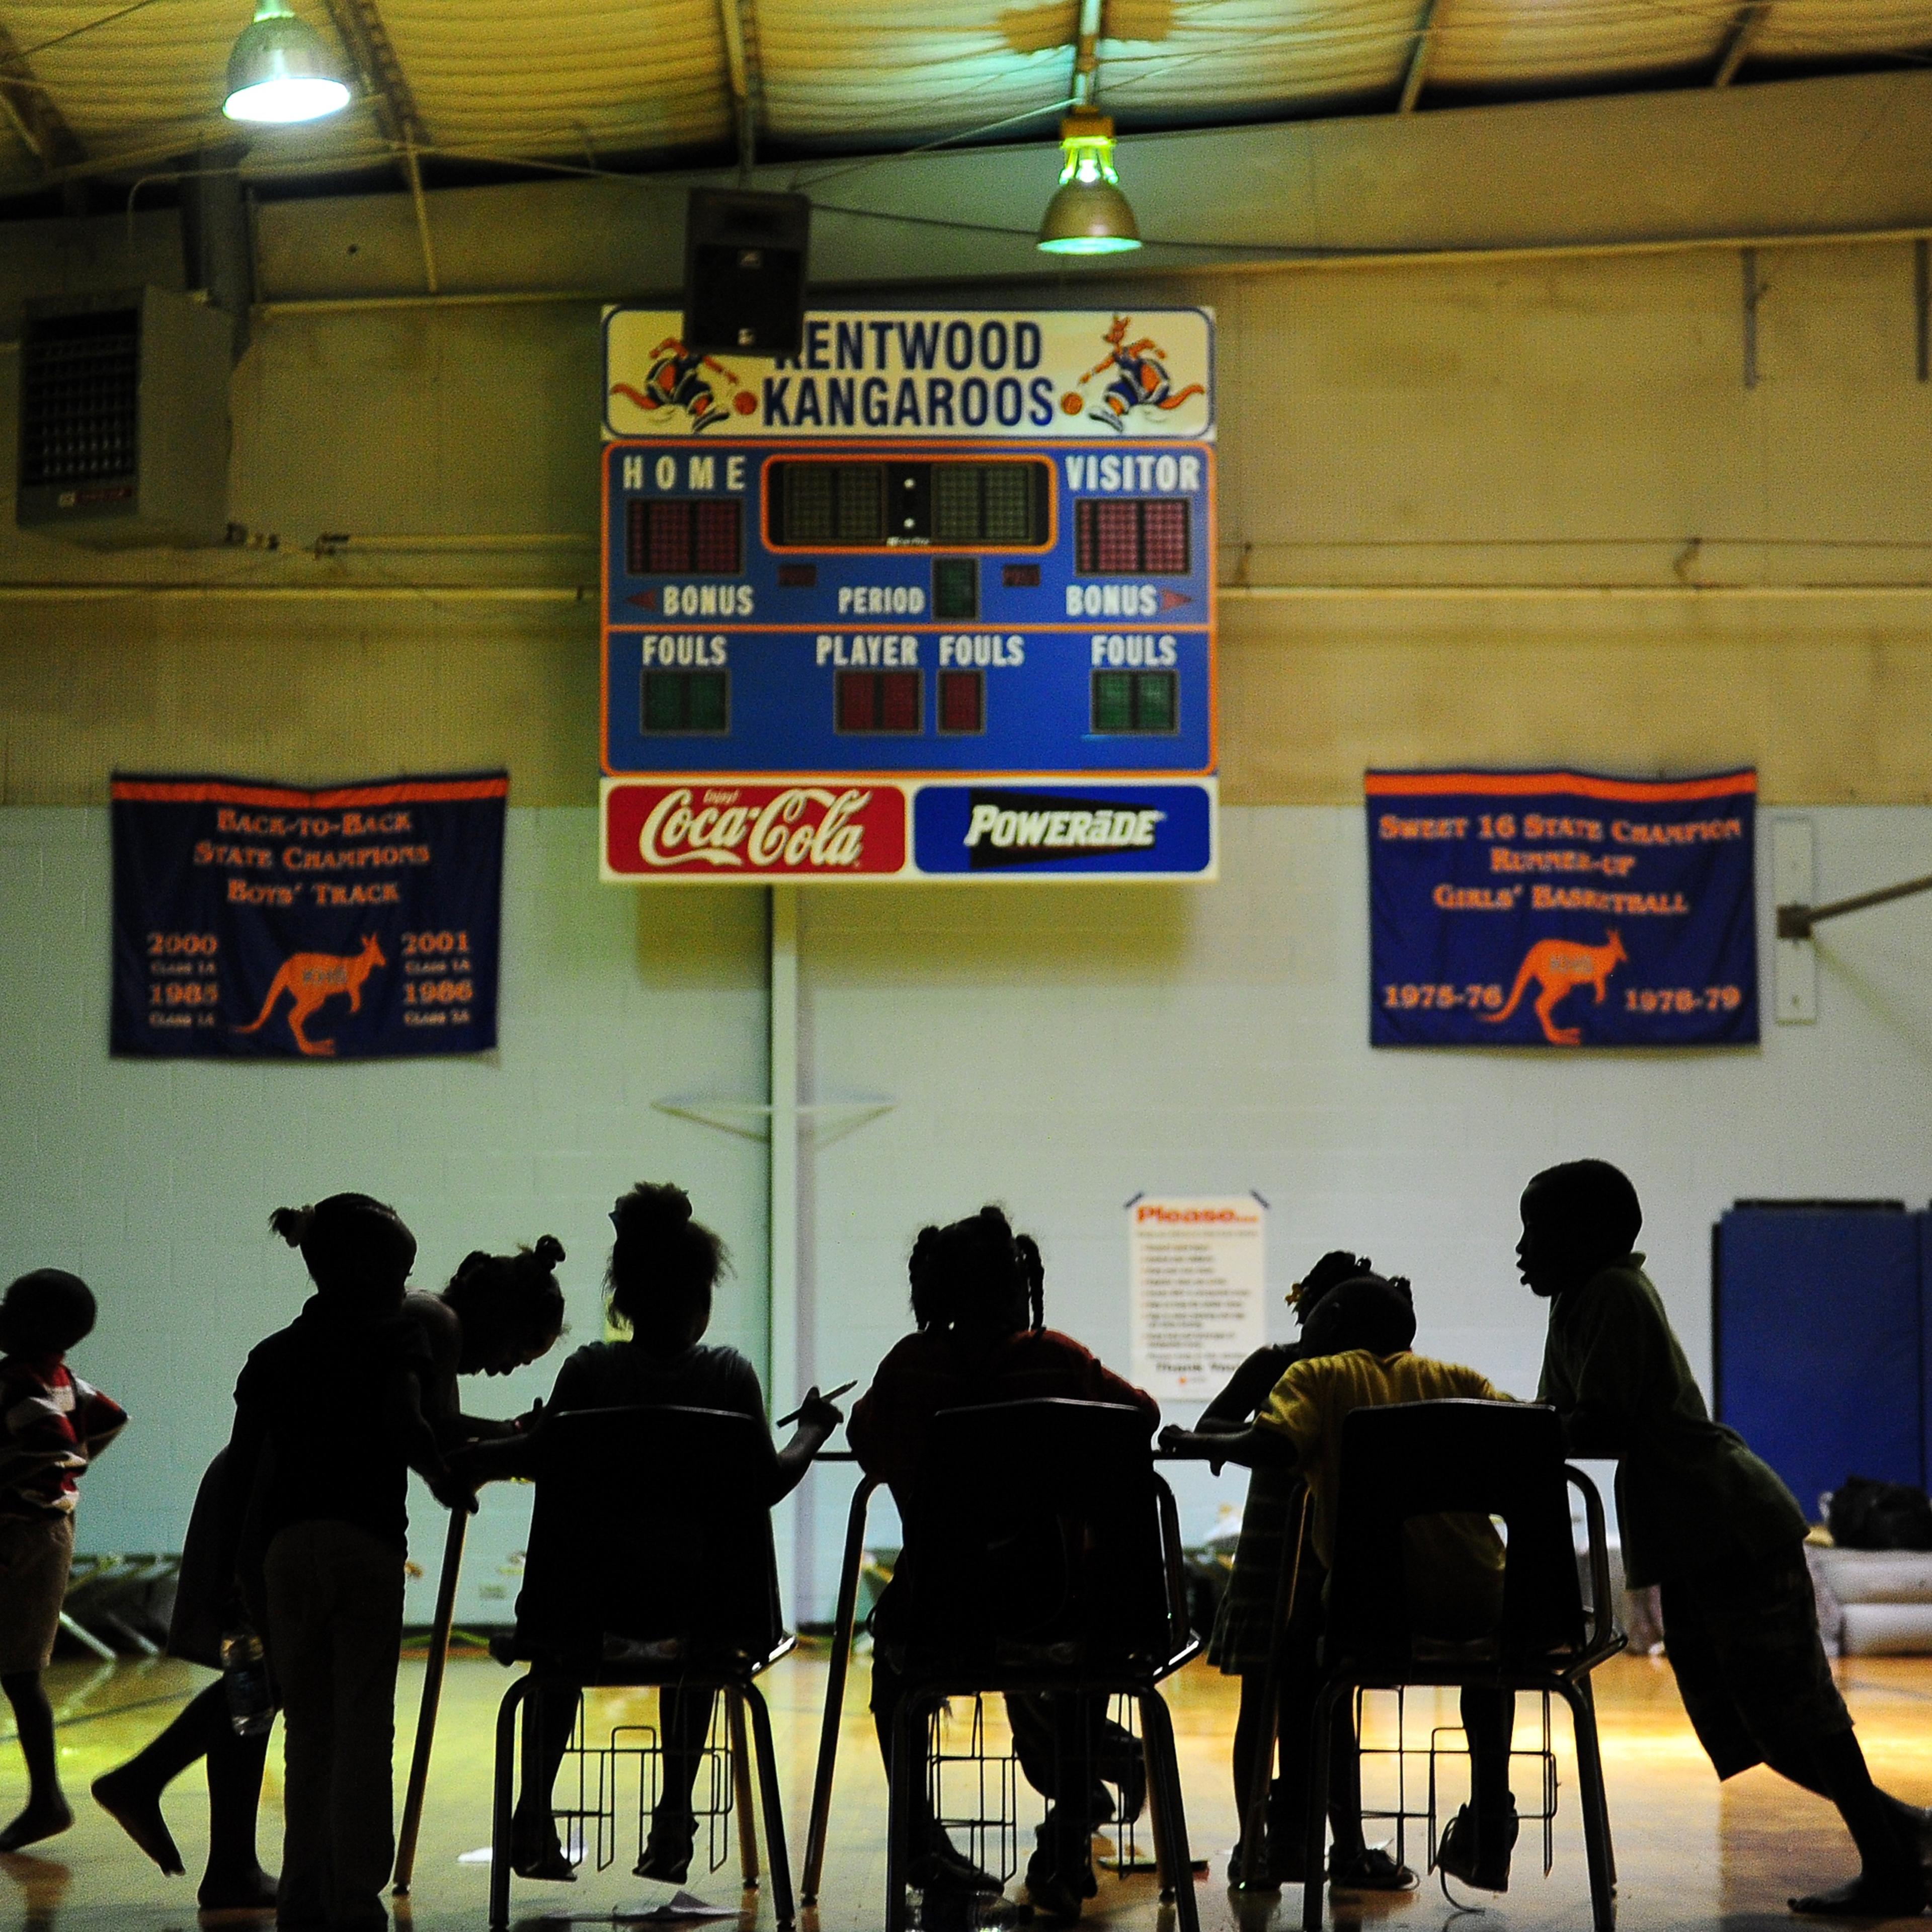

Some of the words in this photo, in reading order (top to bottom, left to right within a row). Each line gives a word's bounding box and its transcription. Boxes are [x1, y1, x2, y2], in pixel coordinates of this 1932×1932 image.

[762, 376, 1054, 427] KANGAROOS
[623, 455, 746, 491] HOME
[1065, 455, 1200, 492] VISITOR
[663, 585, 754, 616] BONUS
[838, 586, 925, 615] PERIOD
[1066, 585, 1157, 617] BONUS
[641, 634, 728, 667] FOULS
[816, 634, 919, 667] PLAYER
[939, 634, 1025, 667] FOULS
[1091, 634, 1177, 667] FOULS
[639, 787, 871, 866] Coca-Cola
[1478, 814, 1517, 840] 16
[281, 844, 432, 871] CHAMPIONS
[311, 881, 400, 906] TRACK
[1531, 884, 1689, 915] BASKETBALL
[148, 933, 219, 955] 2000
[402, 931, 469, 955] 2001
